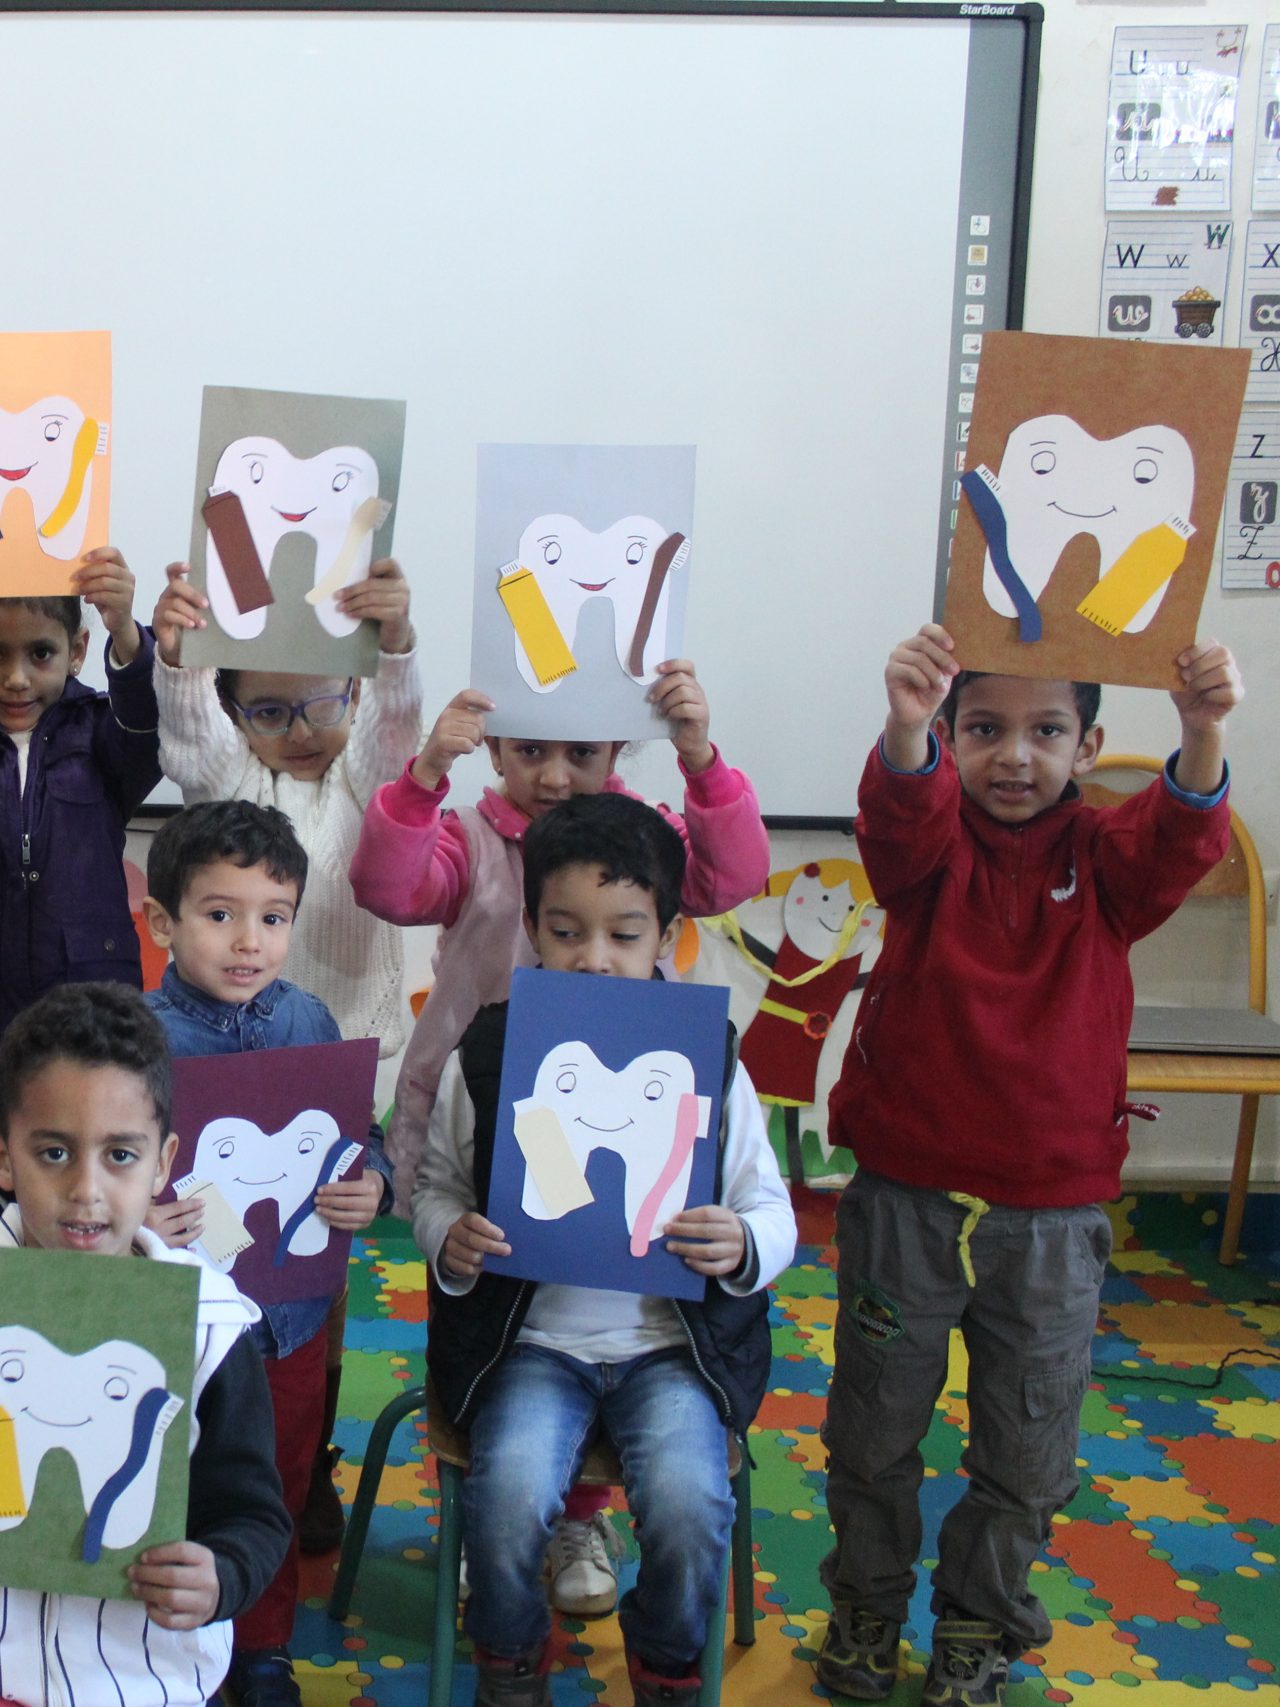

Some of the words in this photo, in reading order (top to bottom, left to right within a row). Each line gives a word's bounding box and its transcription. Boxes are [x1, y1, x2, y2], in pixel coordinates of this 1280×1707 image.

[959, 4, 1016, 15] StarBoard
[1128, 49, 1148, 75] U
[1206, 224, 1231, 250] W
[1116, 243, 1146, 269] W
[1166, 254, 1188, 269] w
